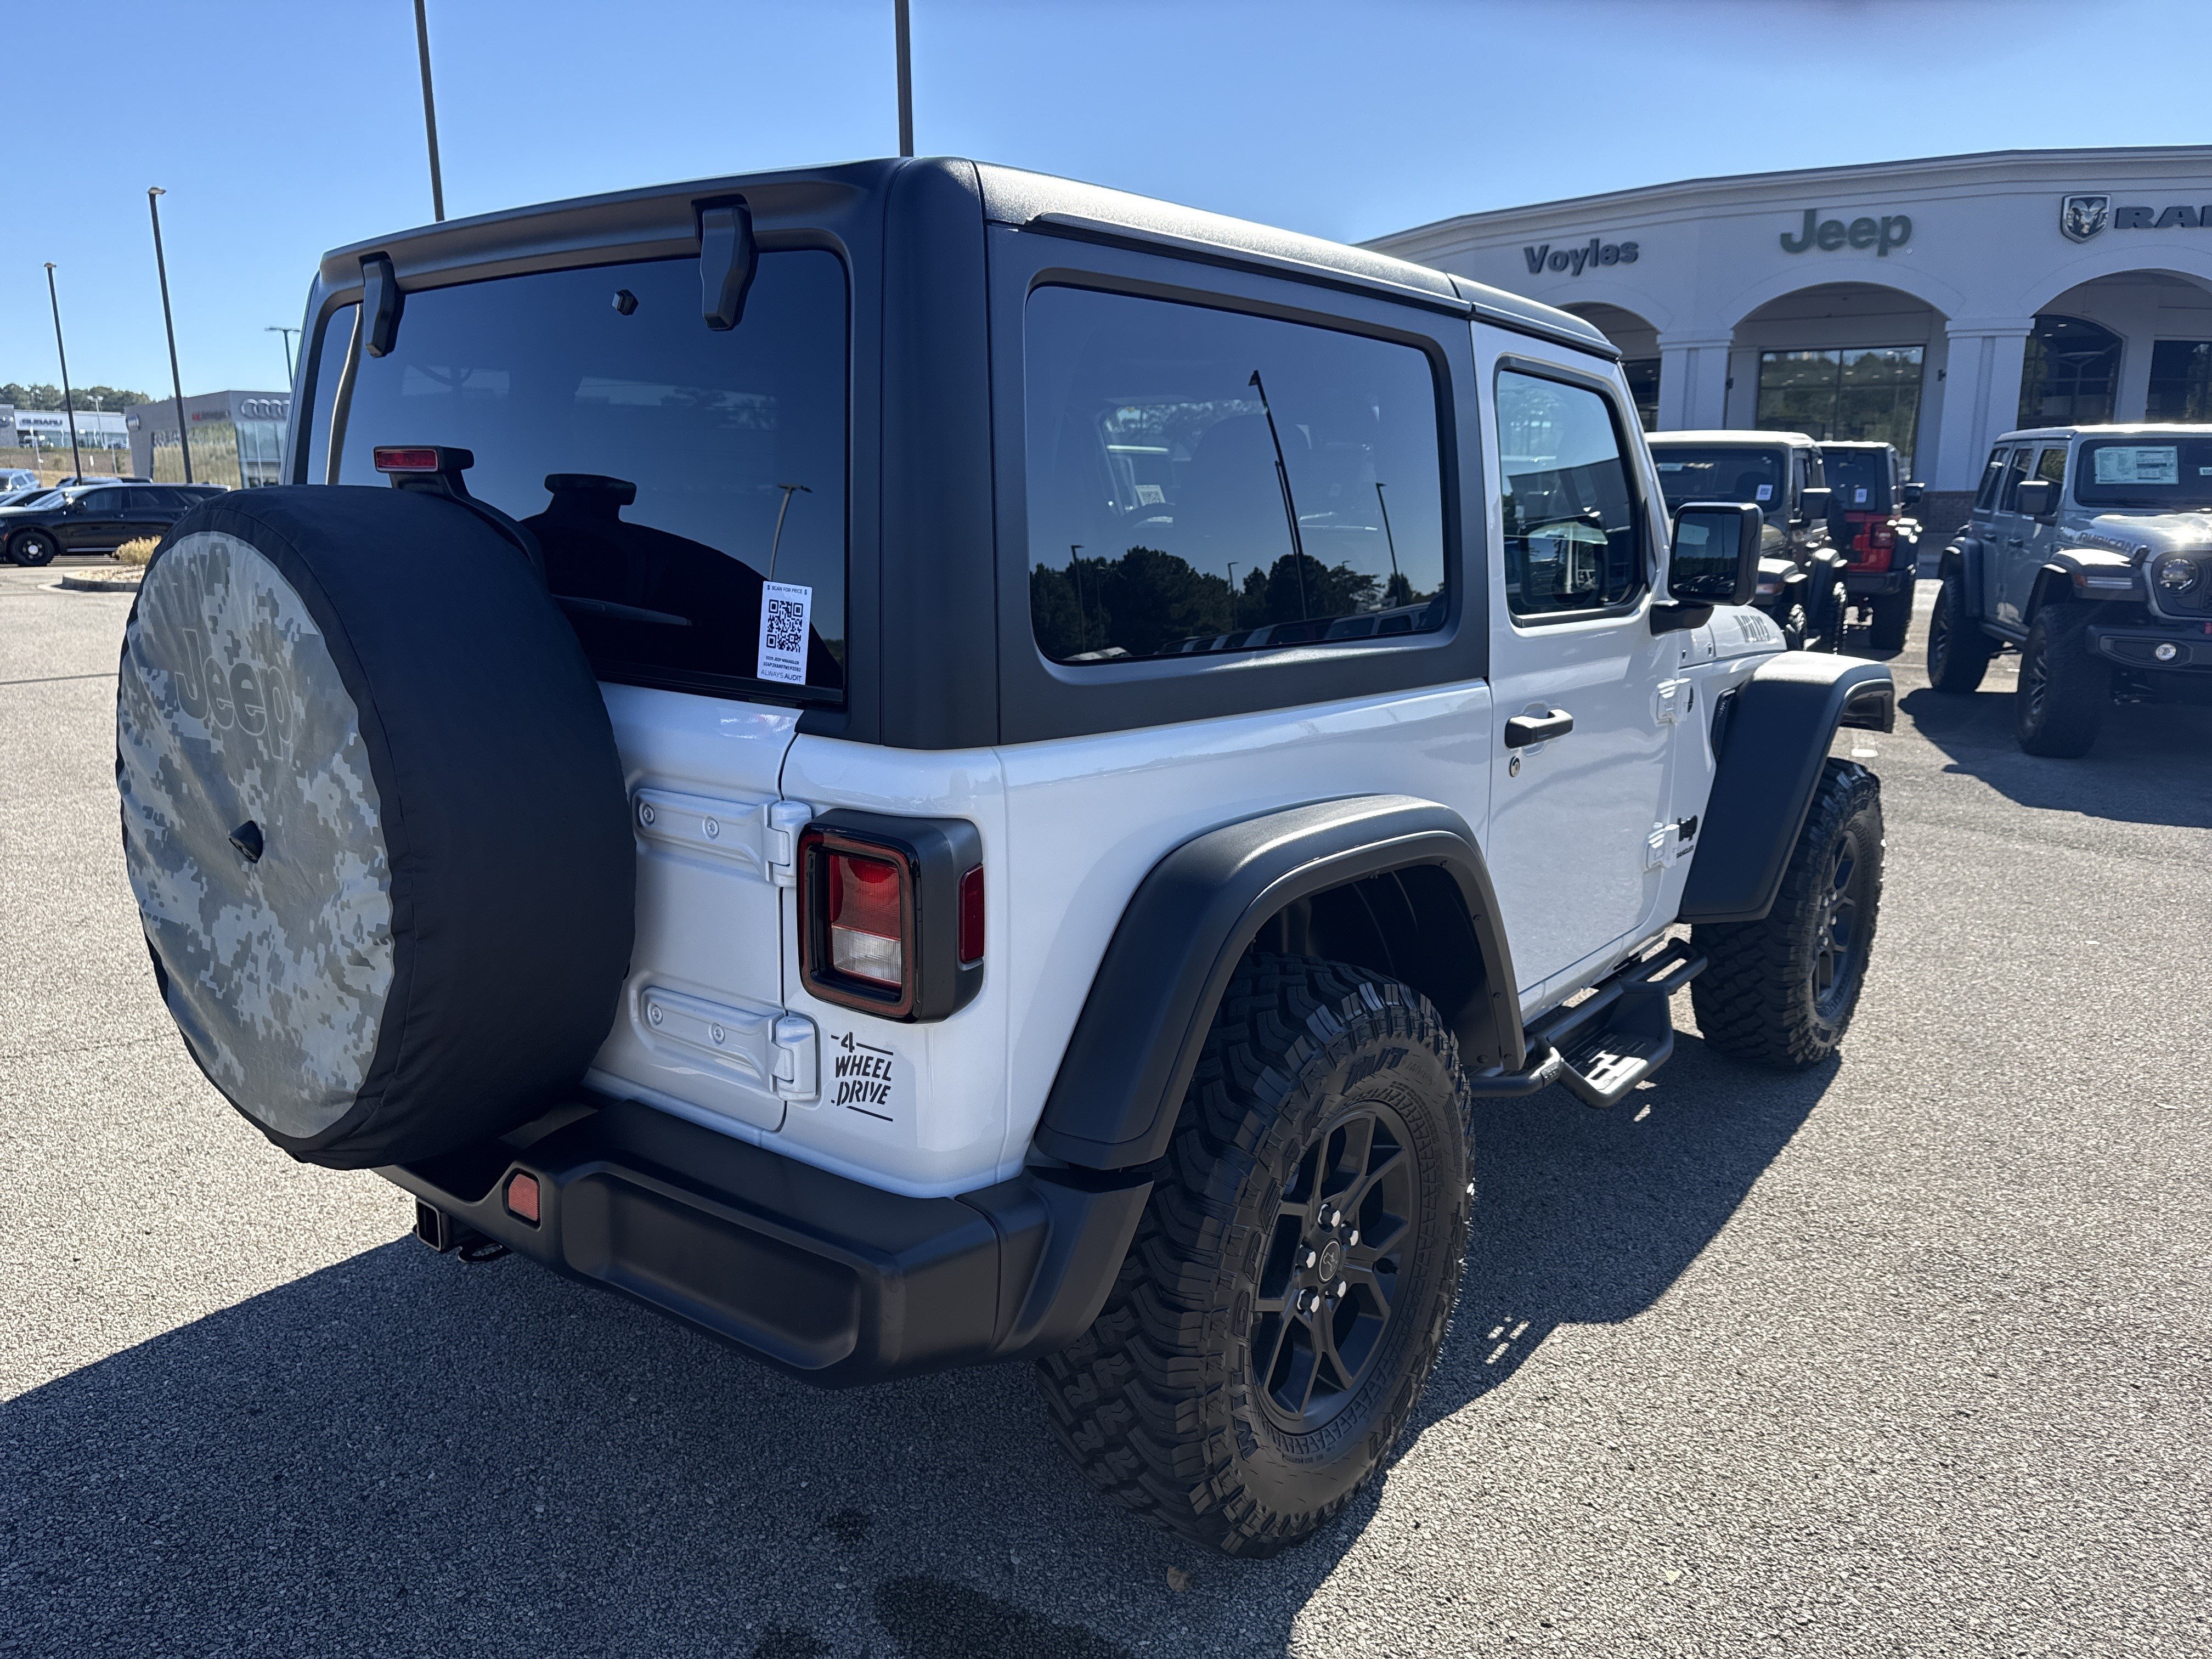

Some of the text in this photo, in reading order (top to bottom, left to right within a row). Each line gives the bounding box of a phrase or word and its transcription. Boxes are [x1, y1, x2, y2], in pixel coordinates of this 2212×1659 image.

[2114, 205, 2212, 229] RA
[1780, 208, 1912, 257] Jeep
[1524, 238, 1639, 276] Voyles
[760, 669, 802, 681] ALWAYS AUDIT
[175, 628, 293, 760] Jeep
[840, 1031, 855, 1053] 4
[835, 1055, 892, 1081] WHEEL
[1340, 1046, 1410, 1096] M/T
[836, 1080, 891, 1107] DRIVE
